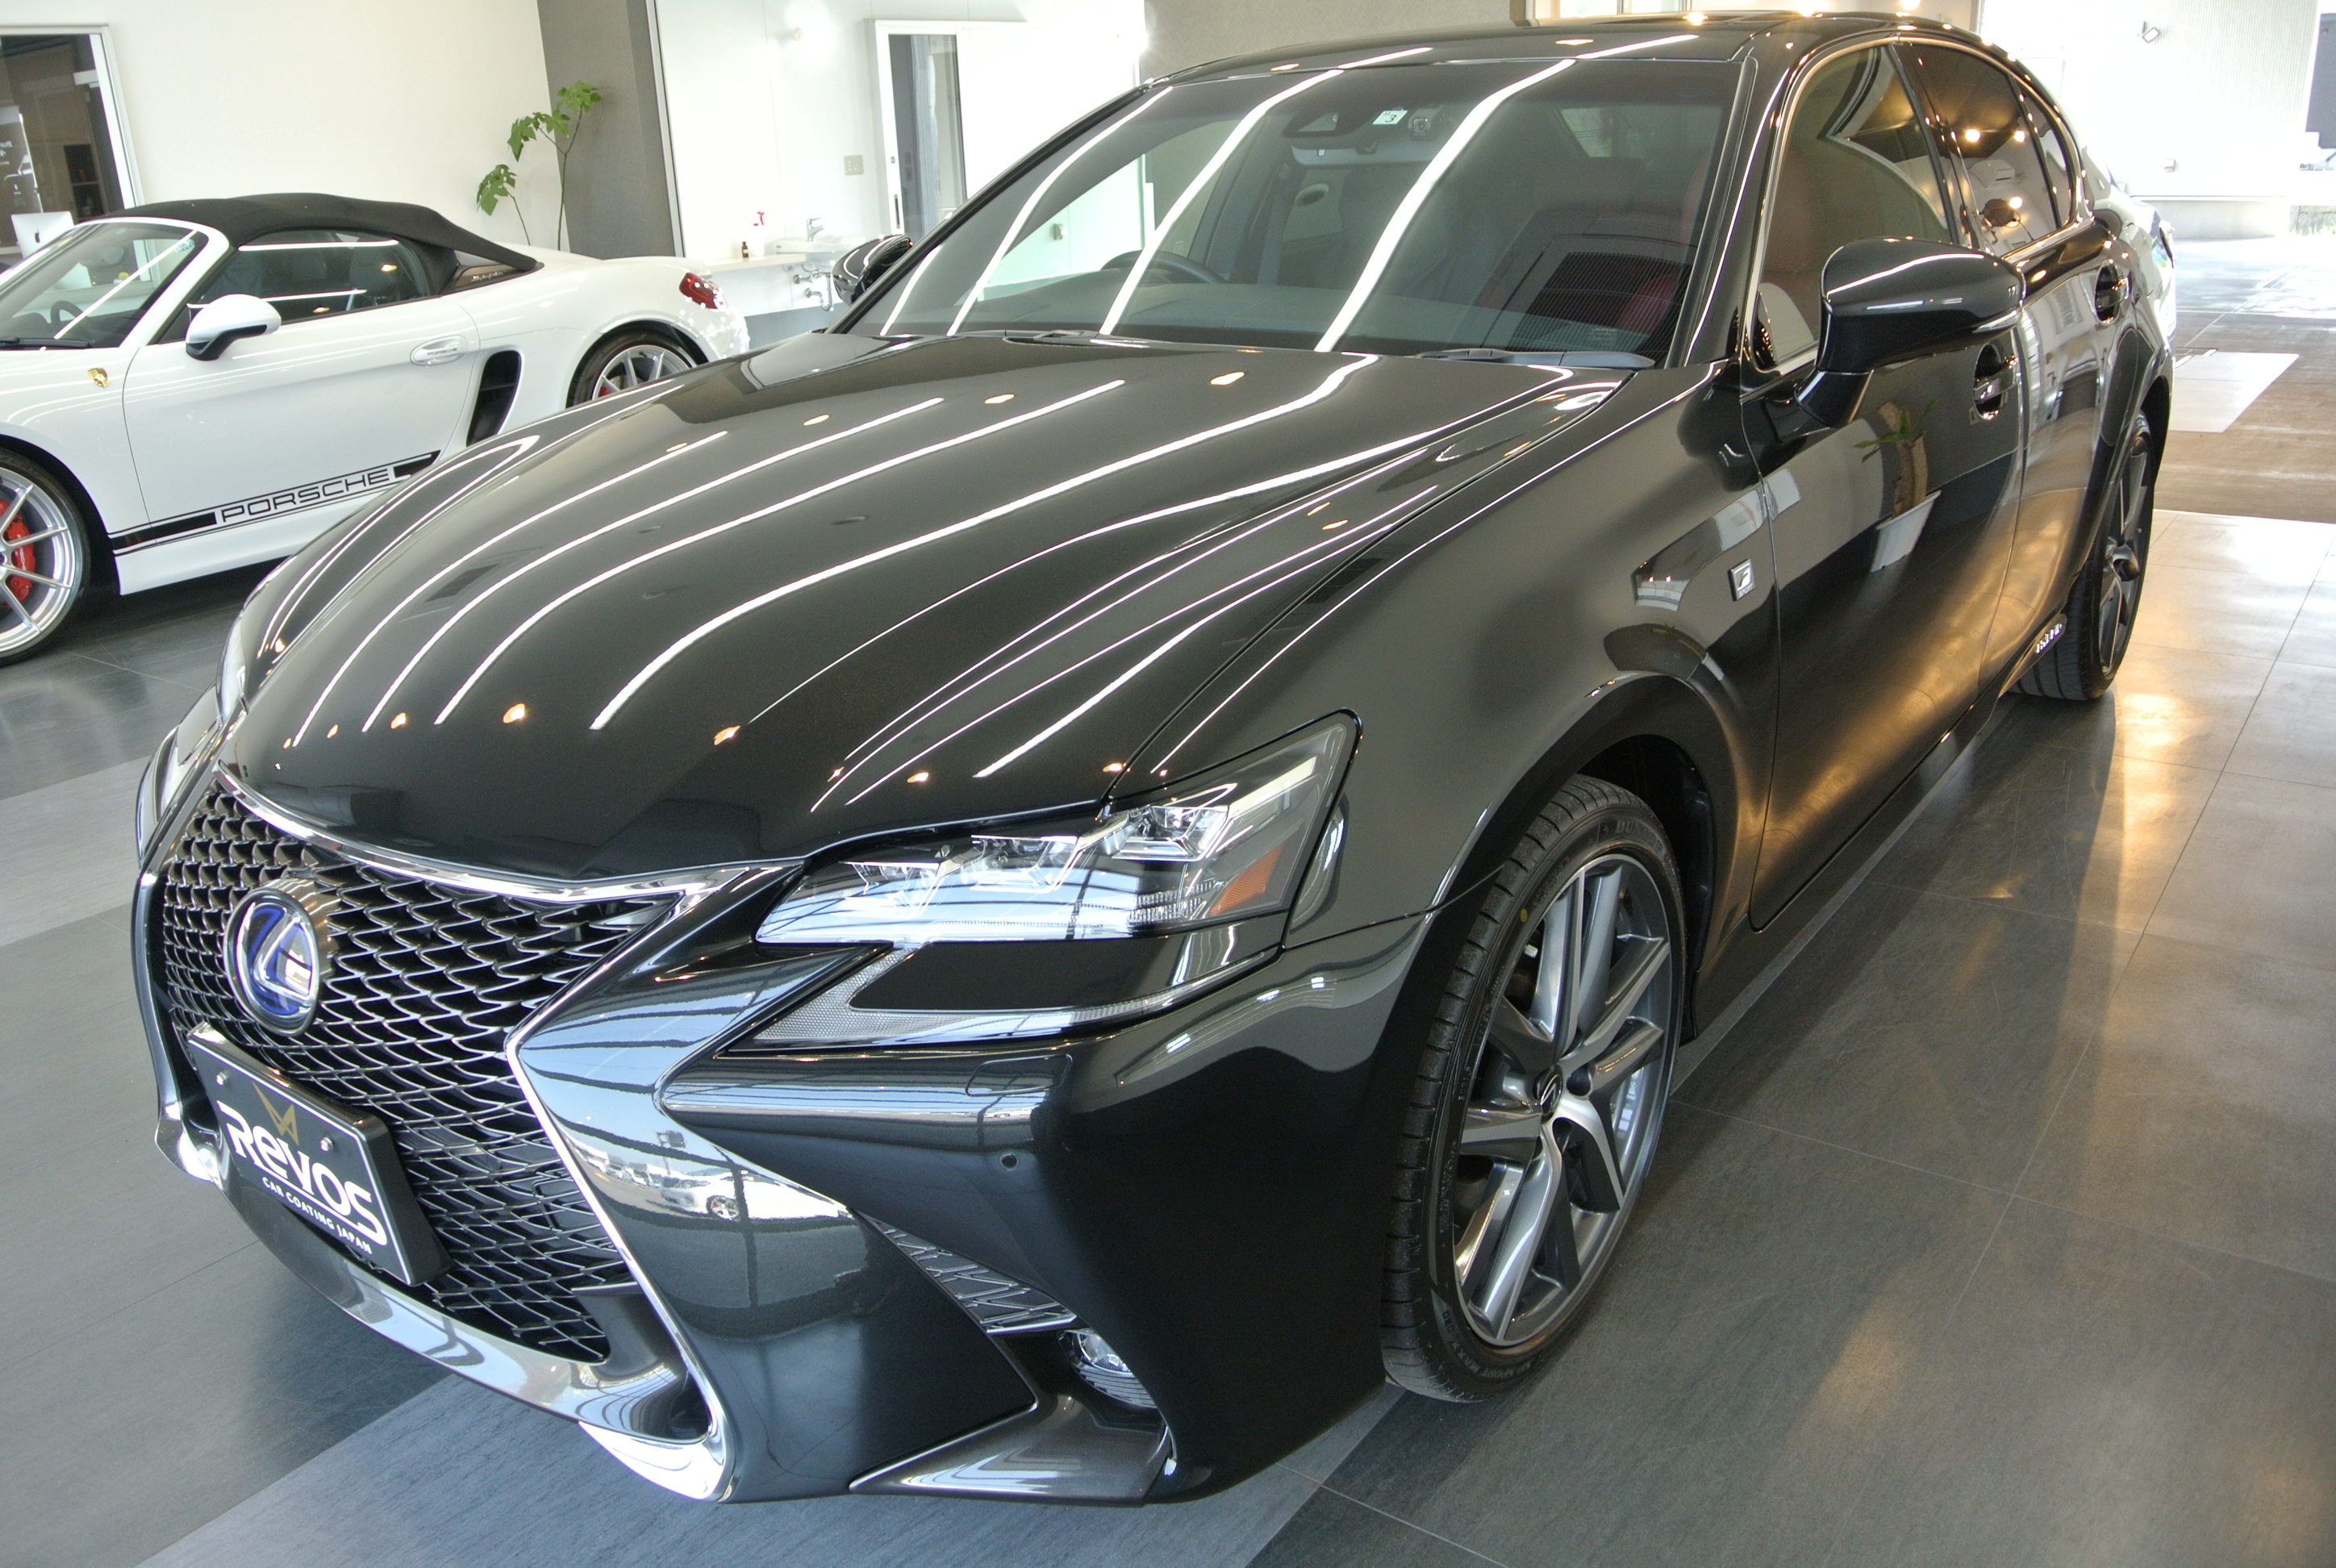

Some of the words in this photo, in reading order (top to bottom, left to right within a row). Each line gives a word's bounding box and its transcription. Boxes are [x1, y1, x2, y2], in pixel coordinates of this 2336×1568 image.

[1385, 115, 1397, 123] 3
[220, 468, 390, 523] PORSCHE
[1737, 582, 1754, 598] SPORT
[262, 1177, 284, 1197] CAR
[286, 1192, 335, 1229] COATING
[336, 1224, 372, 1254] JAPAN
